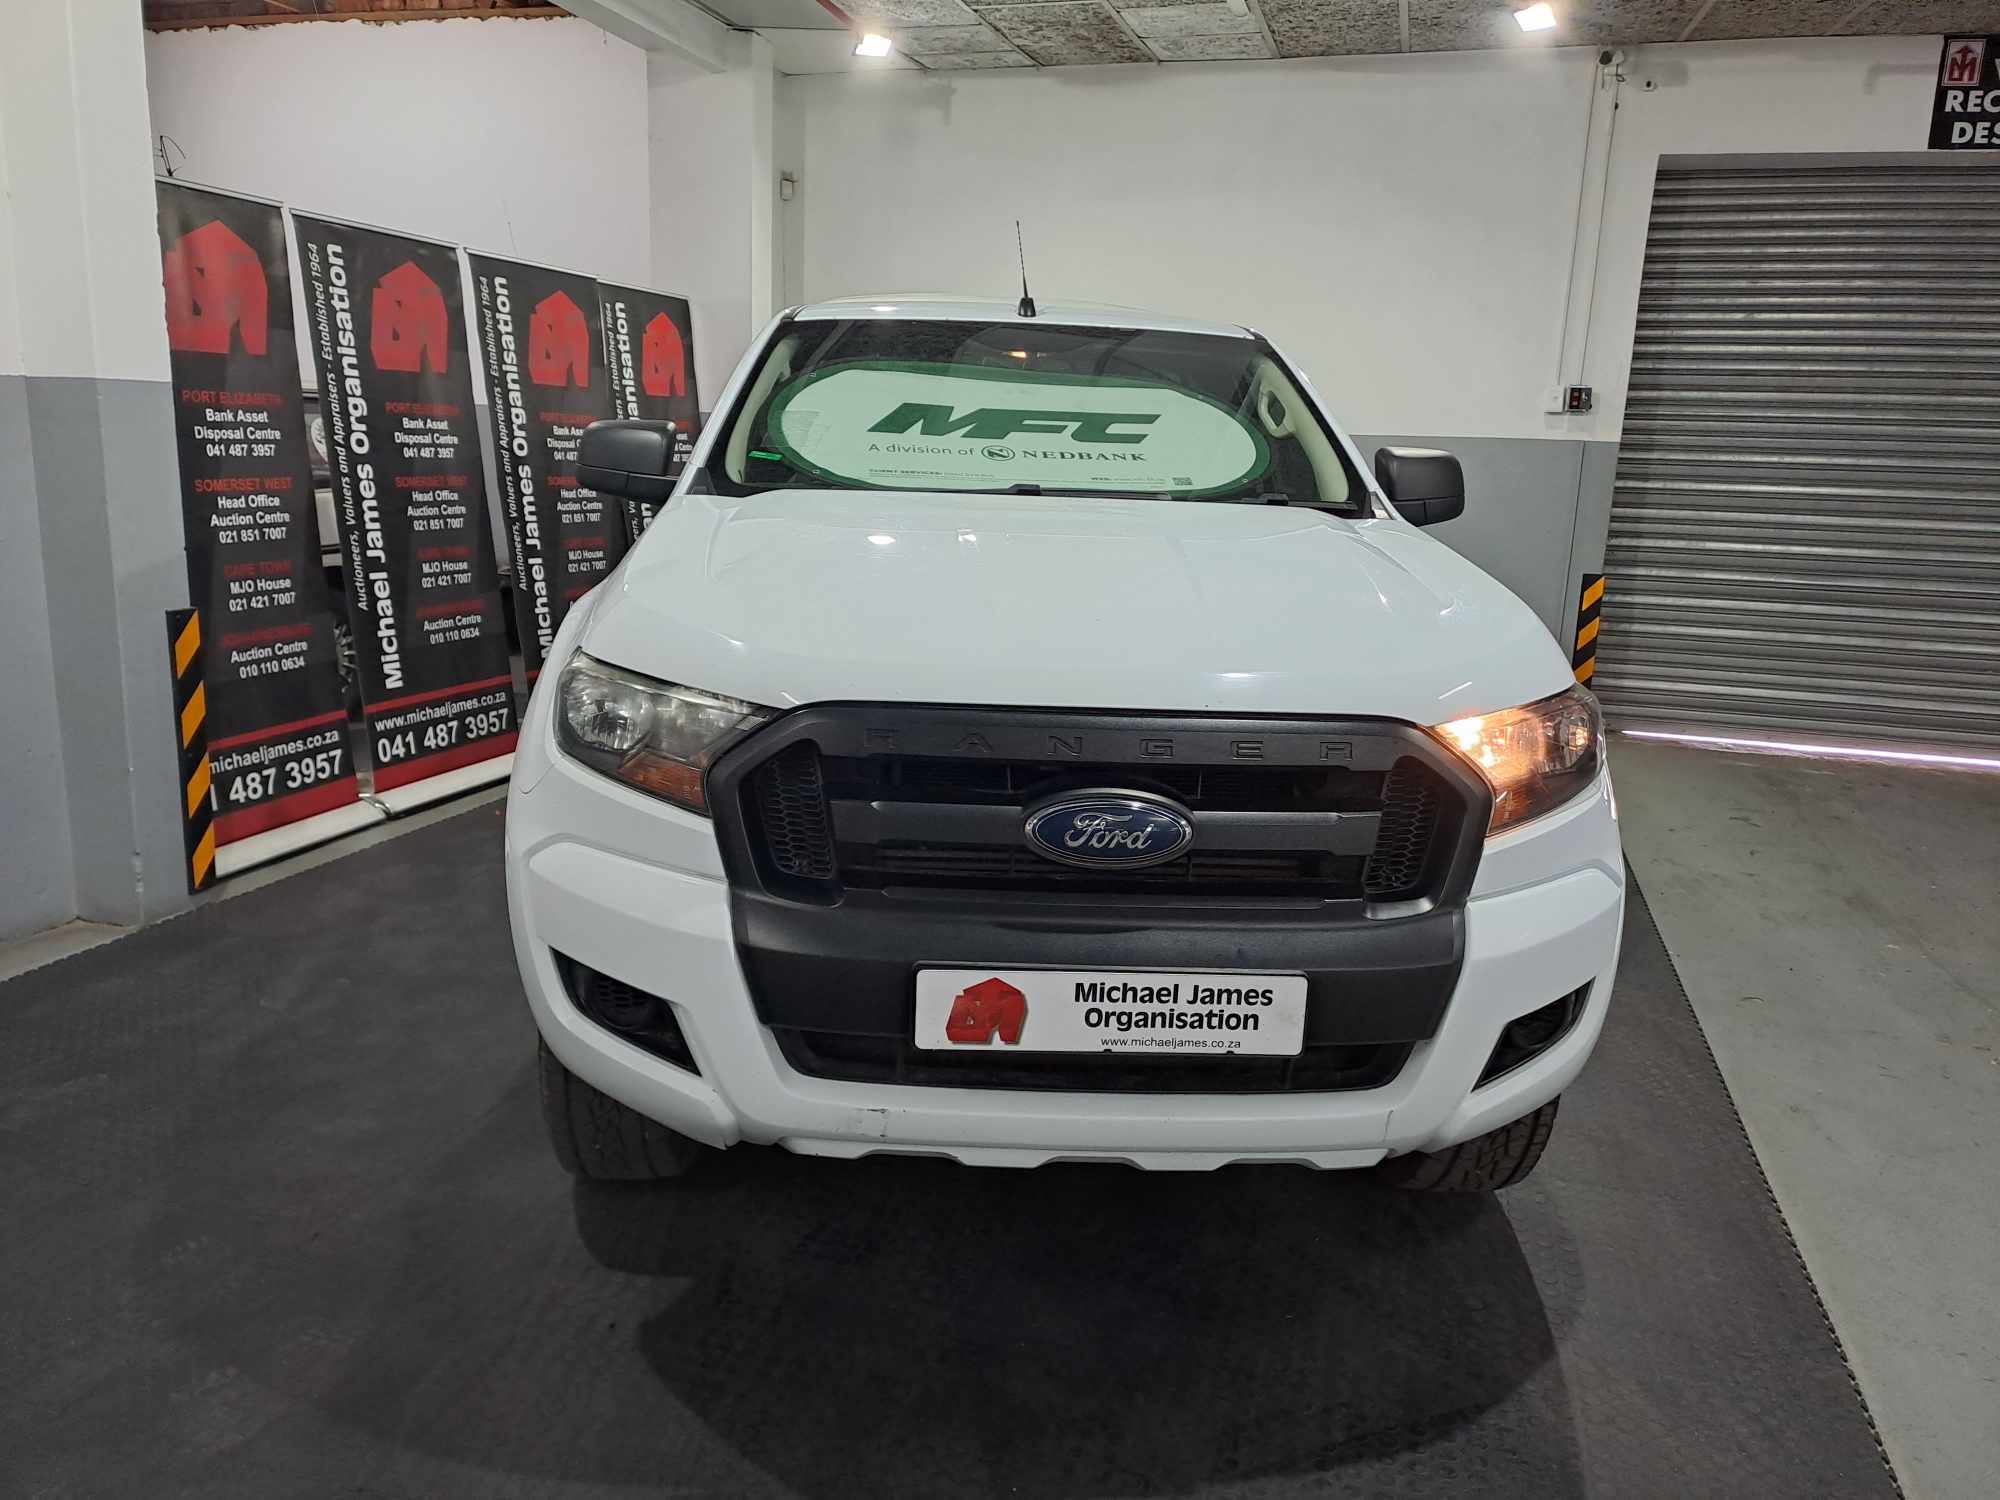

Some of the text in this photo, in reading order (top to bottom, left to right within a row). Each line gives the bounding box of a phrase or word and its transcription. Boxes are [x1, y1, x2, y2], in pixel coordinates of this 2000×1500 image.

[308, 242, 321, 278] 1964
[480, 276, 491, 306] 1964
[312, 280, 333, 361] Established
[483, 308, 499, 377] Established
[615, 302, 640, 420] anisation
[205, 408, 269, 423] Bank Asset
[327, 372, 345, 445] Appraisers
[194, 426, 281, 442] Disposal Centre
[402, 417, 449, 430] Bank Asset
[866, 402, 1161, 444] MFC
[394, 431, 459, 445] Disposal Centre
[206, 444, 276, 457] 041 487 3957
[335, 446, 349, 473] and
[403, 447, 418, 458] 041
[420, 447, 435, 458] 487
[501, 449, 511, 473] and
[868, 443, 1147, 462] A division of NEDBANK
[327, 243, 404, 689] Michael James Organisation
[494, 276, 553, 659] Michael James Organisation
[217, 494, 281, 509] Head Office
[341, 476, 356, 526] Valuers
[412, 490, 459, 502] Head Office
[505, 475, 518, 518] Valuers
[210, 511, 291, 527] Auction Centre
[407, 504, 467, 517] Auction Centre
[219, 527, 287, 544] 021 851 7007
[413, 519, 428, 531] 021
[422, 560, 468, 573] MJO House
[512, 521, 527, 591] Auctioneers,
[350, 530, 368, 611] Auctioneers,
[421, 576, 436, 588] 021
[437, 574, 452, 586] 421
[229, 578, 292, 594] MJO House
[228, 591, 296, 612] 021 421 7007
[423, 614, 482, 631] Auction Centre
[430, 632, 444, 645] 010
[445, 630, 460, 642] 110
[230, 640, 308, 663] Auction Centre
[239, 656, 305, 679] 010 110 0634
[374, 691, 506, 732] www.michaeljames.co.za
[377, 708, 508, 763] 041 487 3957
[863, 728, 1354, 761] RANGER
[229, 767, 276, 803] 487
[285, 748, 342, 789] 3957
[1064, 811, 1155, 849] Ford
[1074, 981, 1273, 1007] Michael James
[1084, 1007, 1260, 1032] Organisation
[1101, 1036, 1241, 1049] www.michaeljames.co.za
